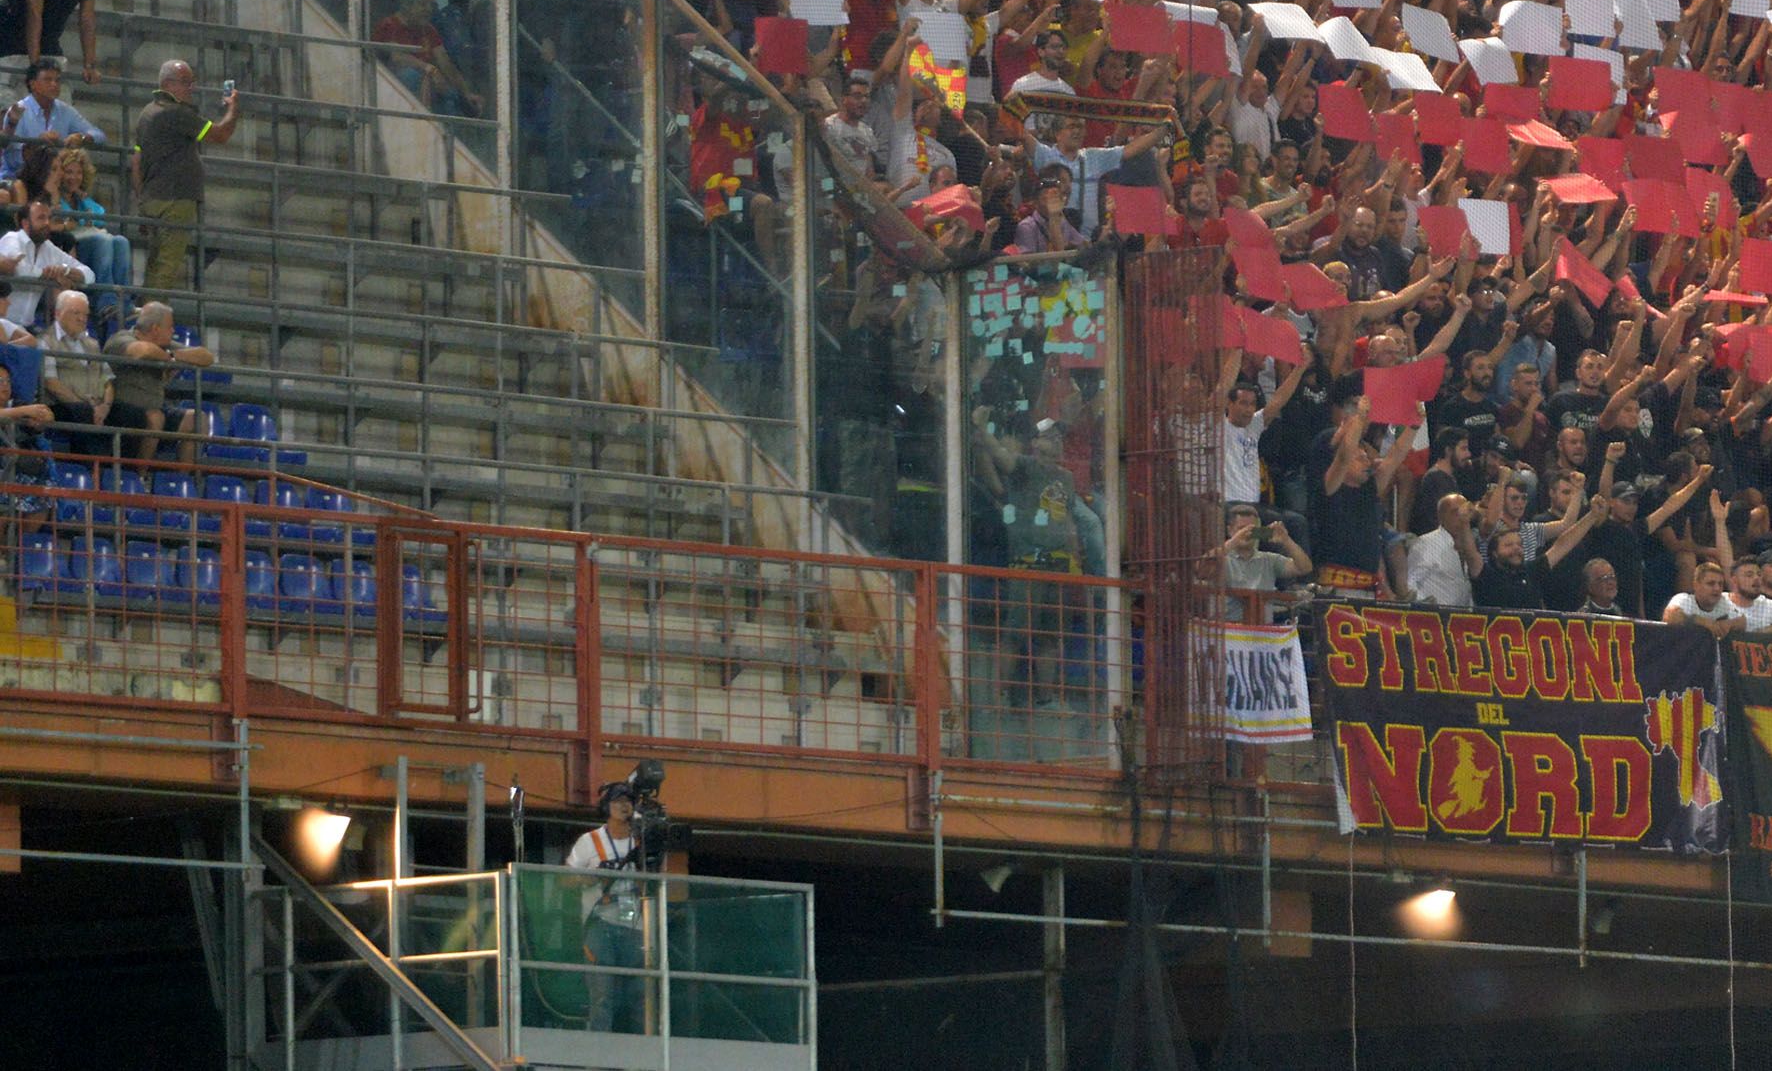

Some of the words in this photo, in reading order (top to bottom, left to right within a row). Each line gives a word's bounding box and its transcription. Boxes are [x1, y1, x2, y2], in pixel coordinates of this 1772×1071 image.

[1325, 604, 1644, 704] STREGONI
[1476, 701, 1510, 727] DEL
[1336, 722, 1653, 842] NORD
